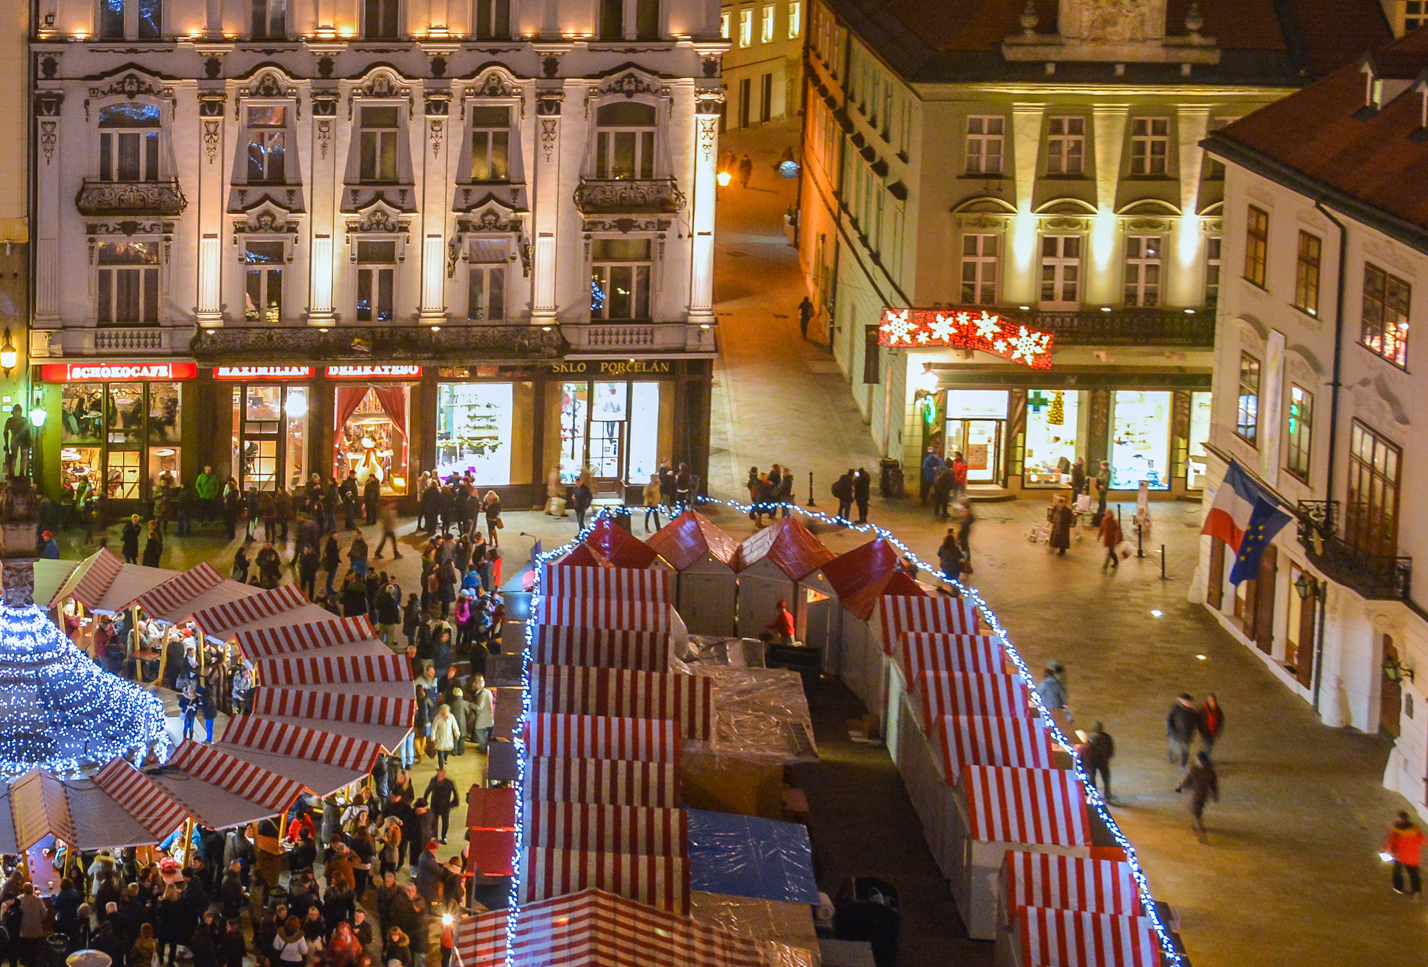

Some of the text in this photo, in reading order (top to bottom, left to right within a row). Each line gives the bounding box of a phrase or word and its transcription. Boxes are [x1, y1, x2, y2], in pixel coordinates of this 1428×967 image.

[217, 366, 309, 376] MAXIMILIAN
[552, 361, 670, 373] SKLO PORCELÁN
